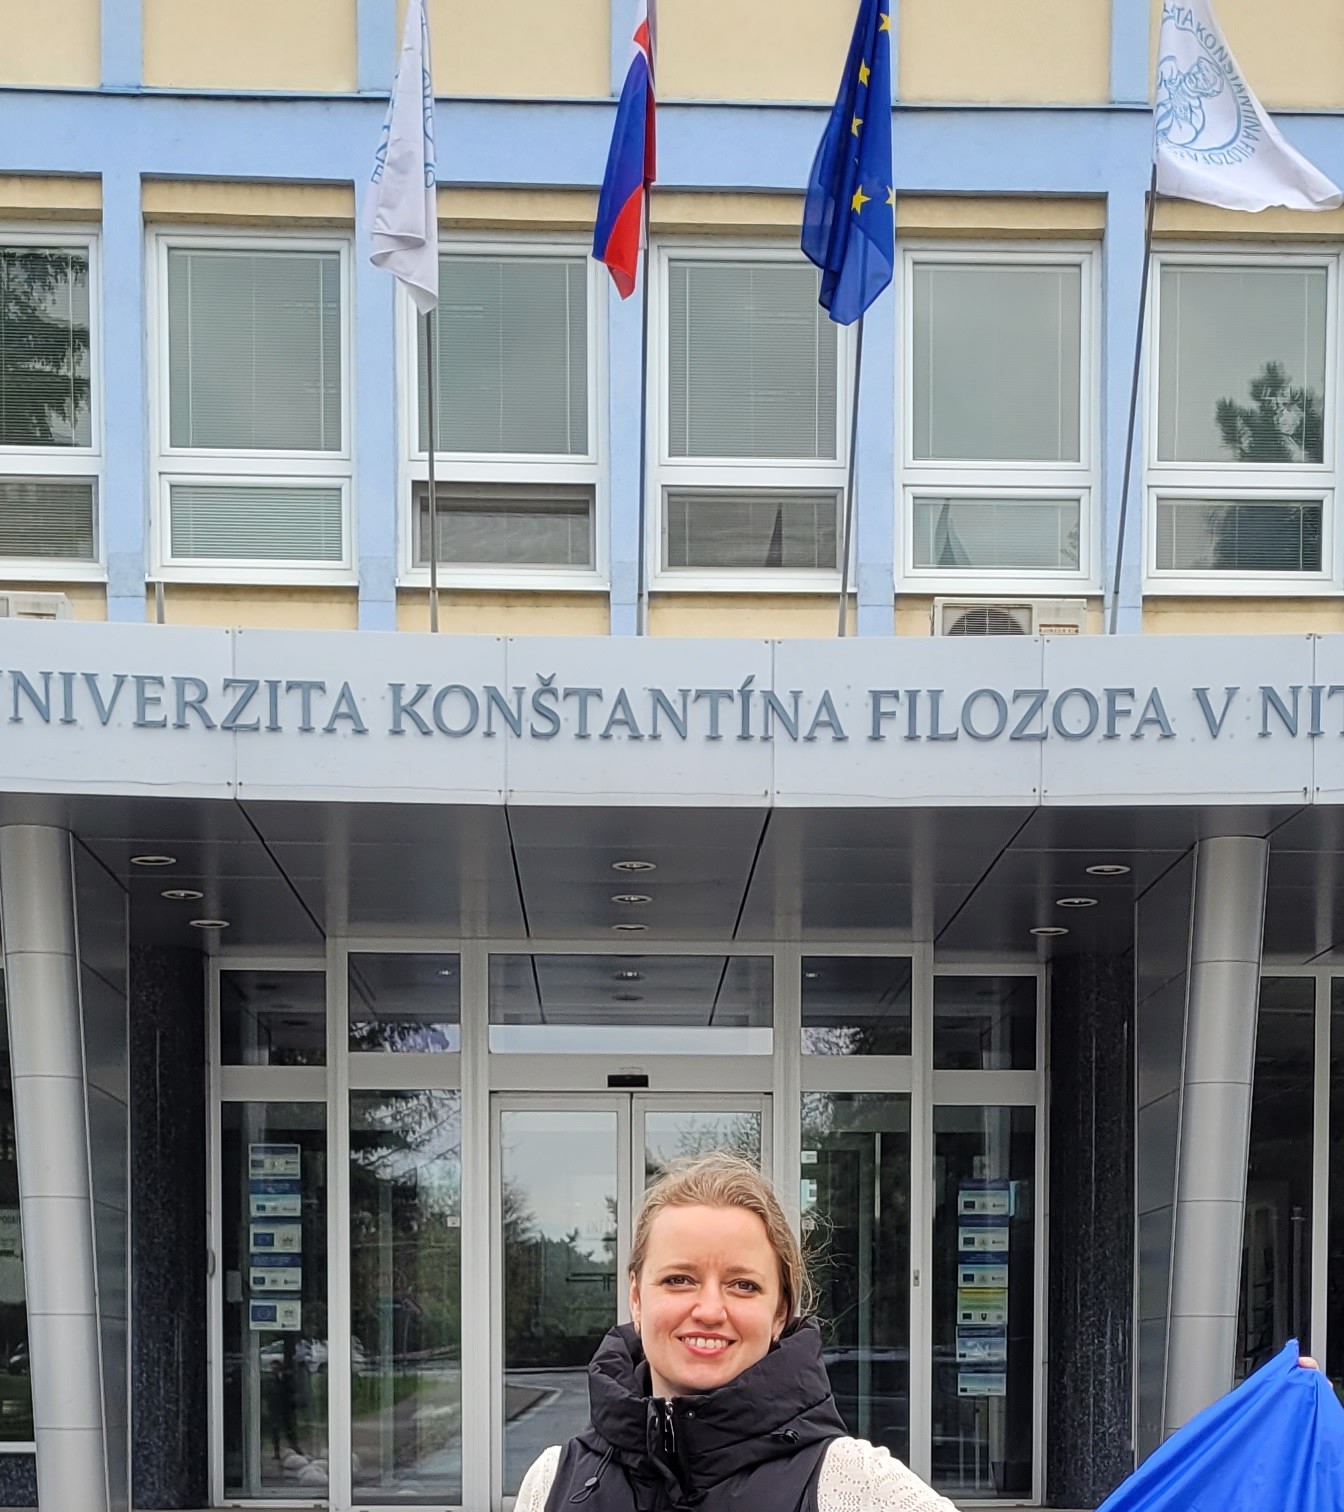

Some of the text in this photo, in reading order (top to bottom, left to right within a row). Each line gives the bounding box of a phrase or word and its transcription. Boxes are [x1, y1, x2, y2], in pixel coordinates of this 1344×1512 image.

[388, 673, 849, 744] KONŠTANTÍNA
[868, 688, 1176, 743] FILOZOFA
[1192, 687, 1240, 740] V
